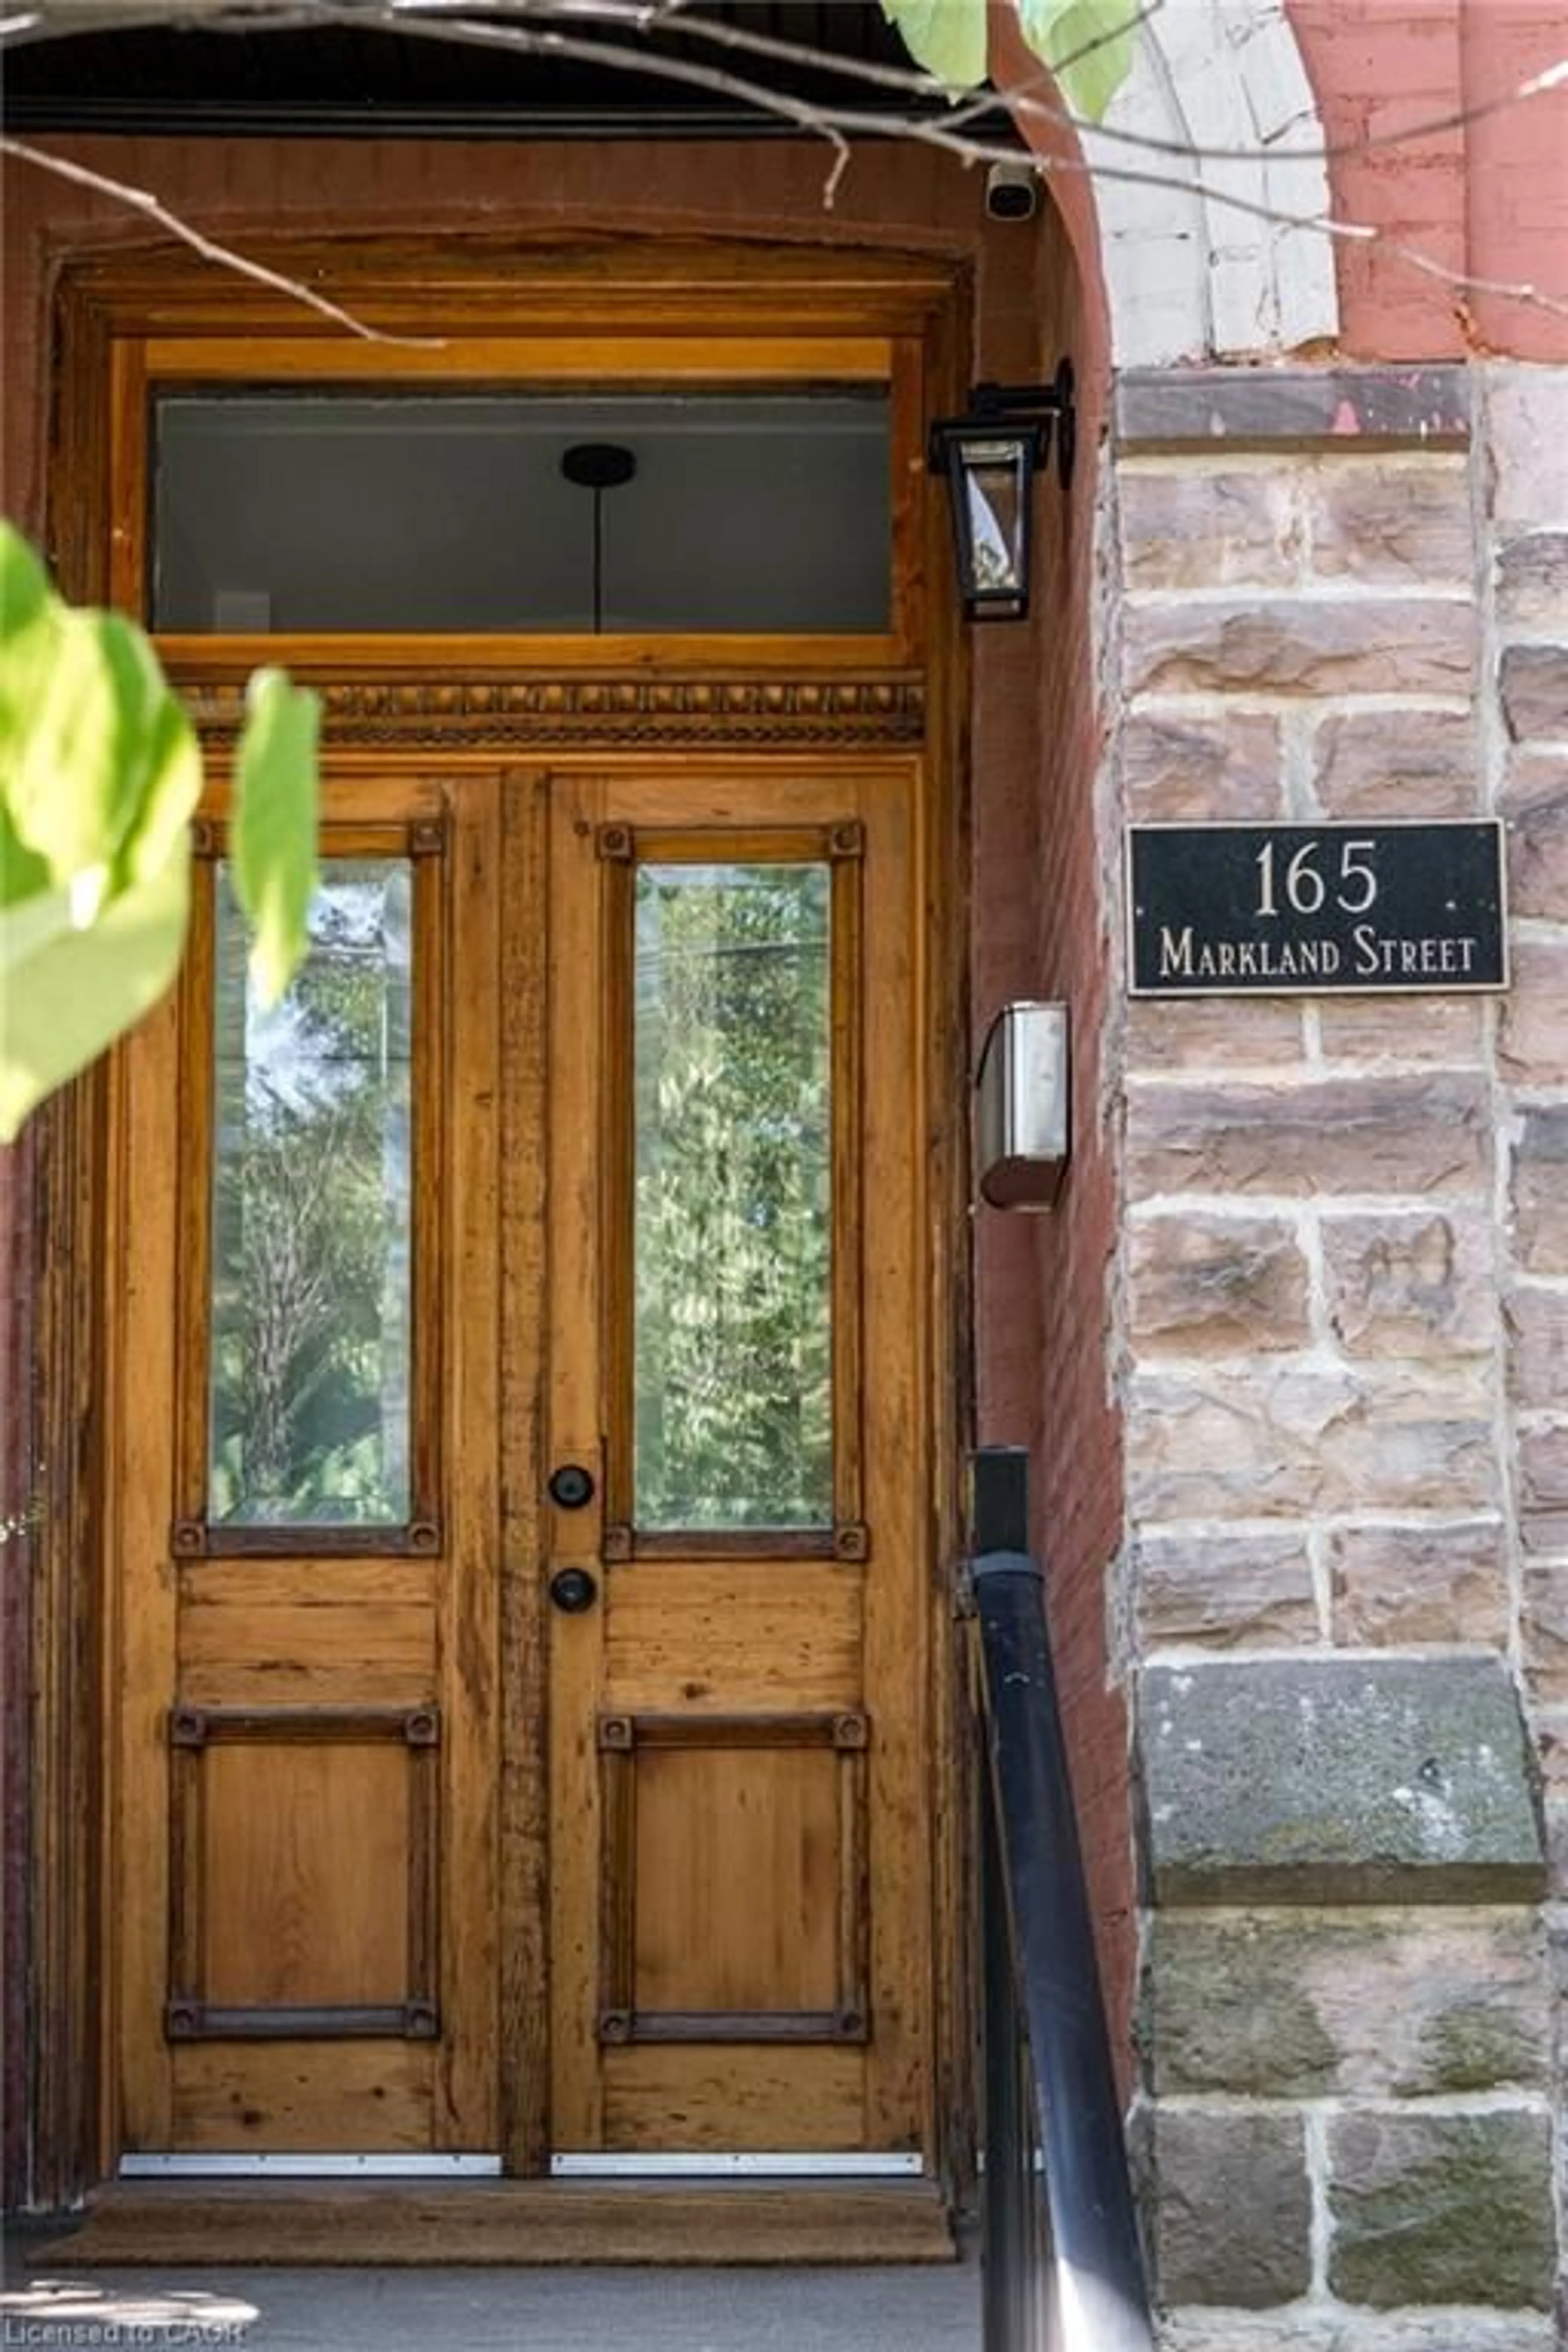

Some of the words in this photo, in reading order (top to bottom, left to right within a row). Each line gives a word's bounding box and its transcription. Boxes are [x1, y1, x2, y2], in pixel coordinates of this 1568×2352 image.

[1255, 840, 1378, 918] 165
[1159, 926, 1340, 977] MARKLAND
[1353, 924, 1477, 974] STREET
